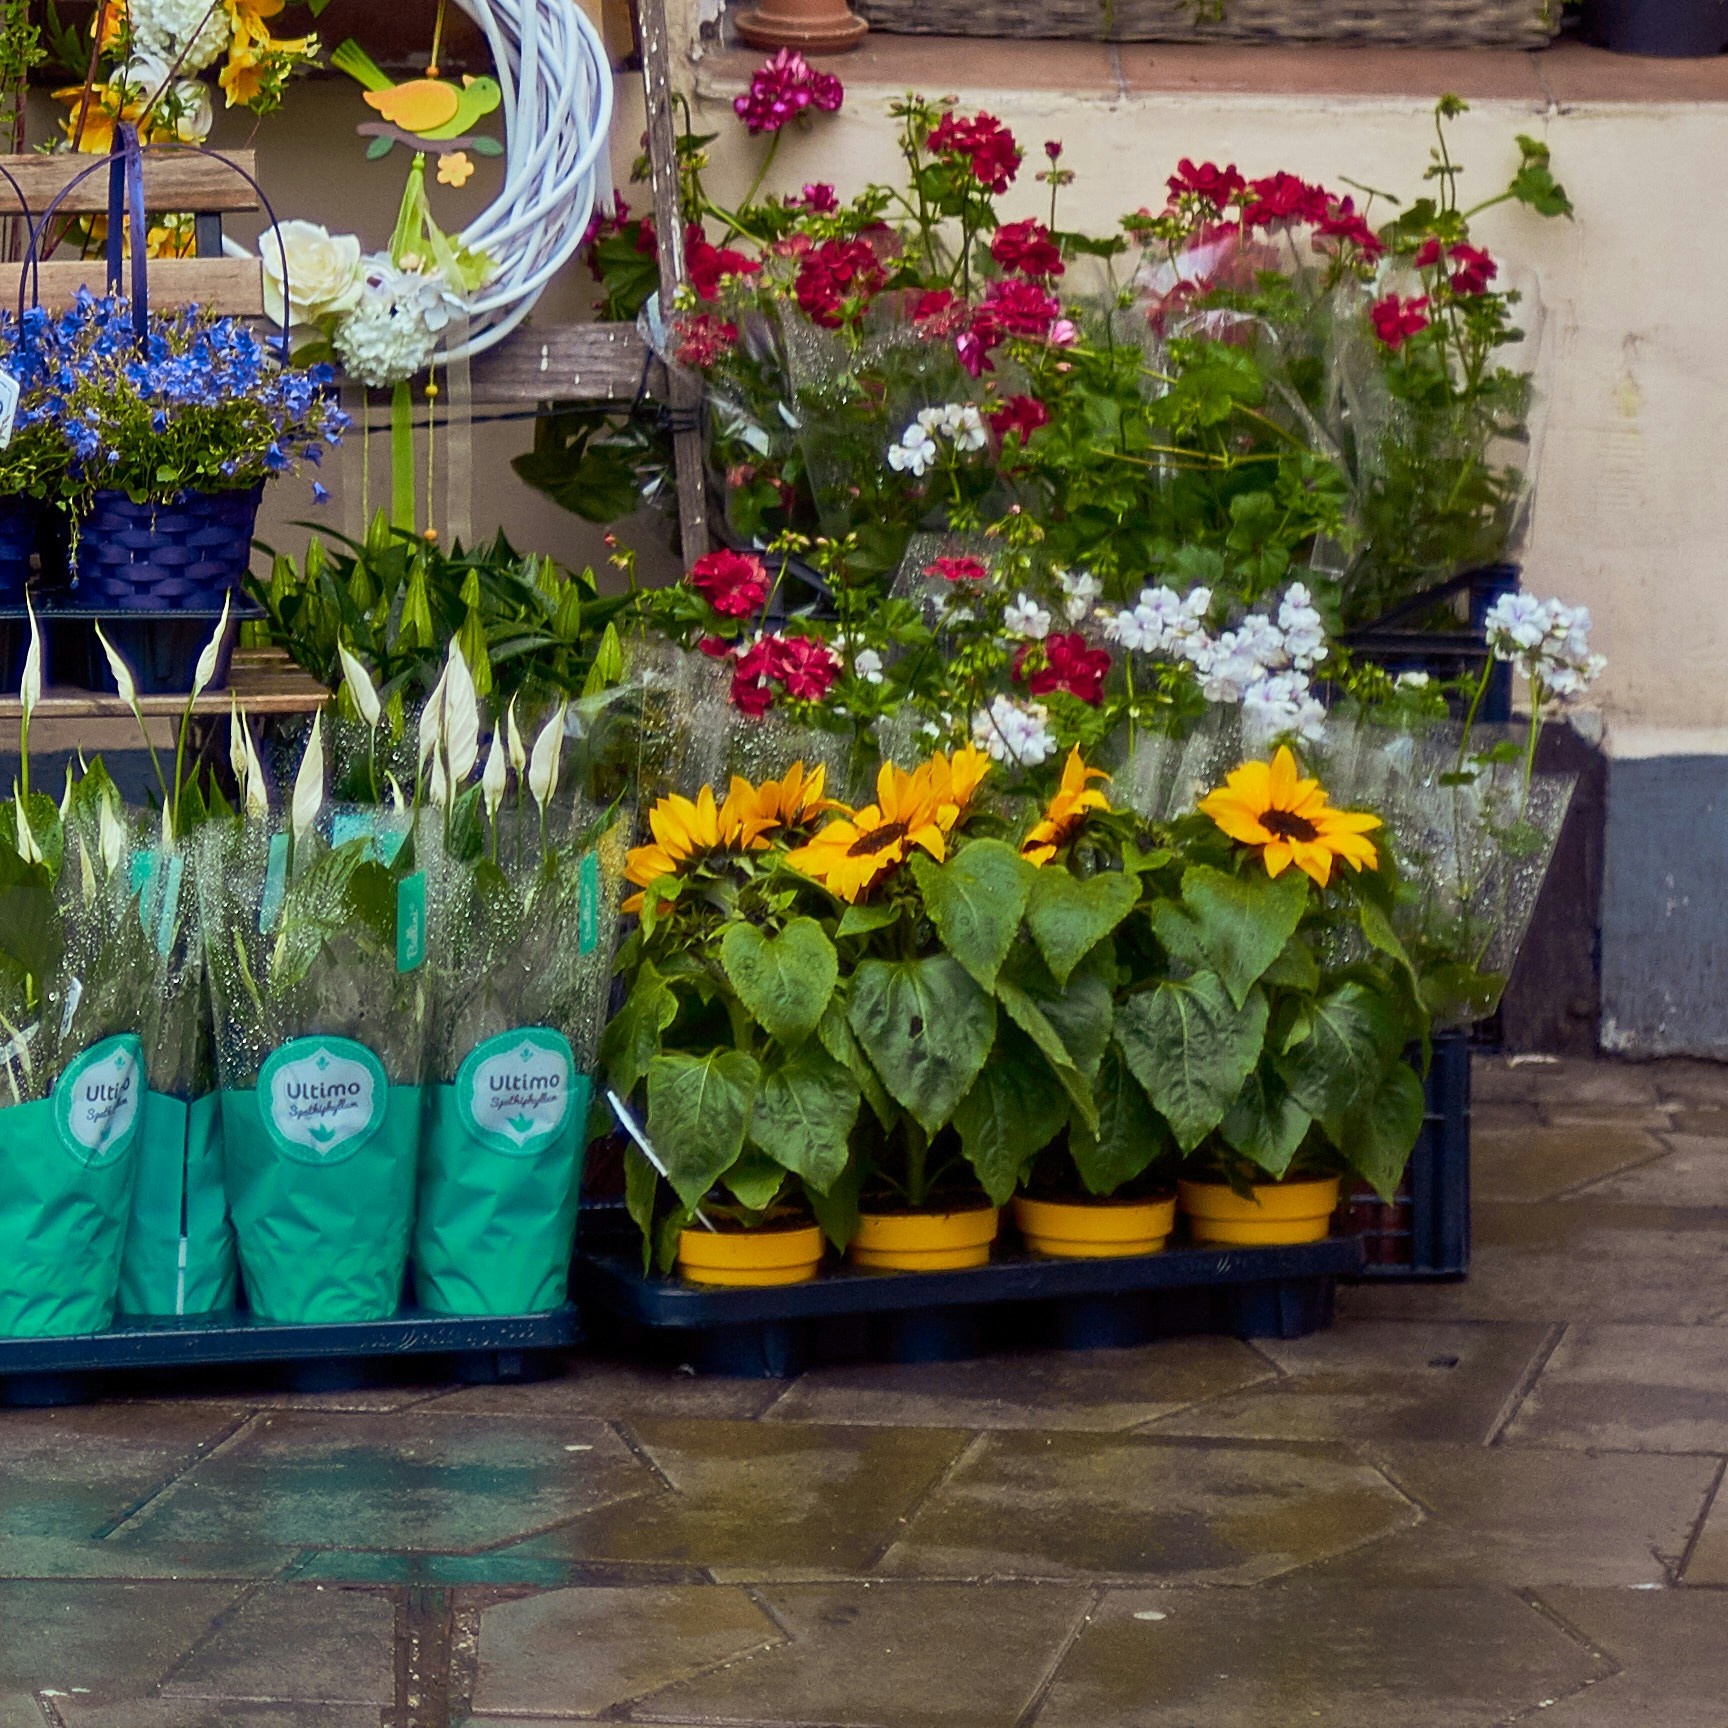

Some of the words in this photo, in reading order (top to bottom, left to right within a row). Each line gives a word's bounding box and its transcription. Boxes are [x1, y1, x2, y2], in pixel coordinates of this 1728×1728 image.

[286, 1081, 361, 1101] Ultimo
[489, 1073, 561, 1092] Ultimo
[288, 1100, 359, 1119] Spathiphyllum
